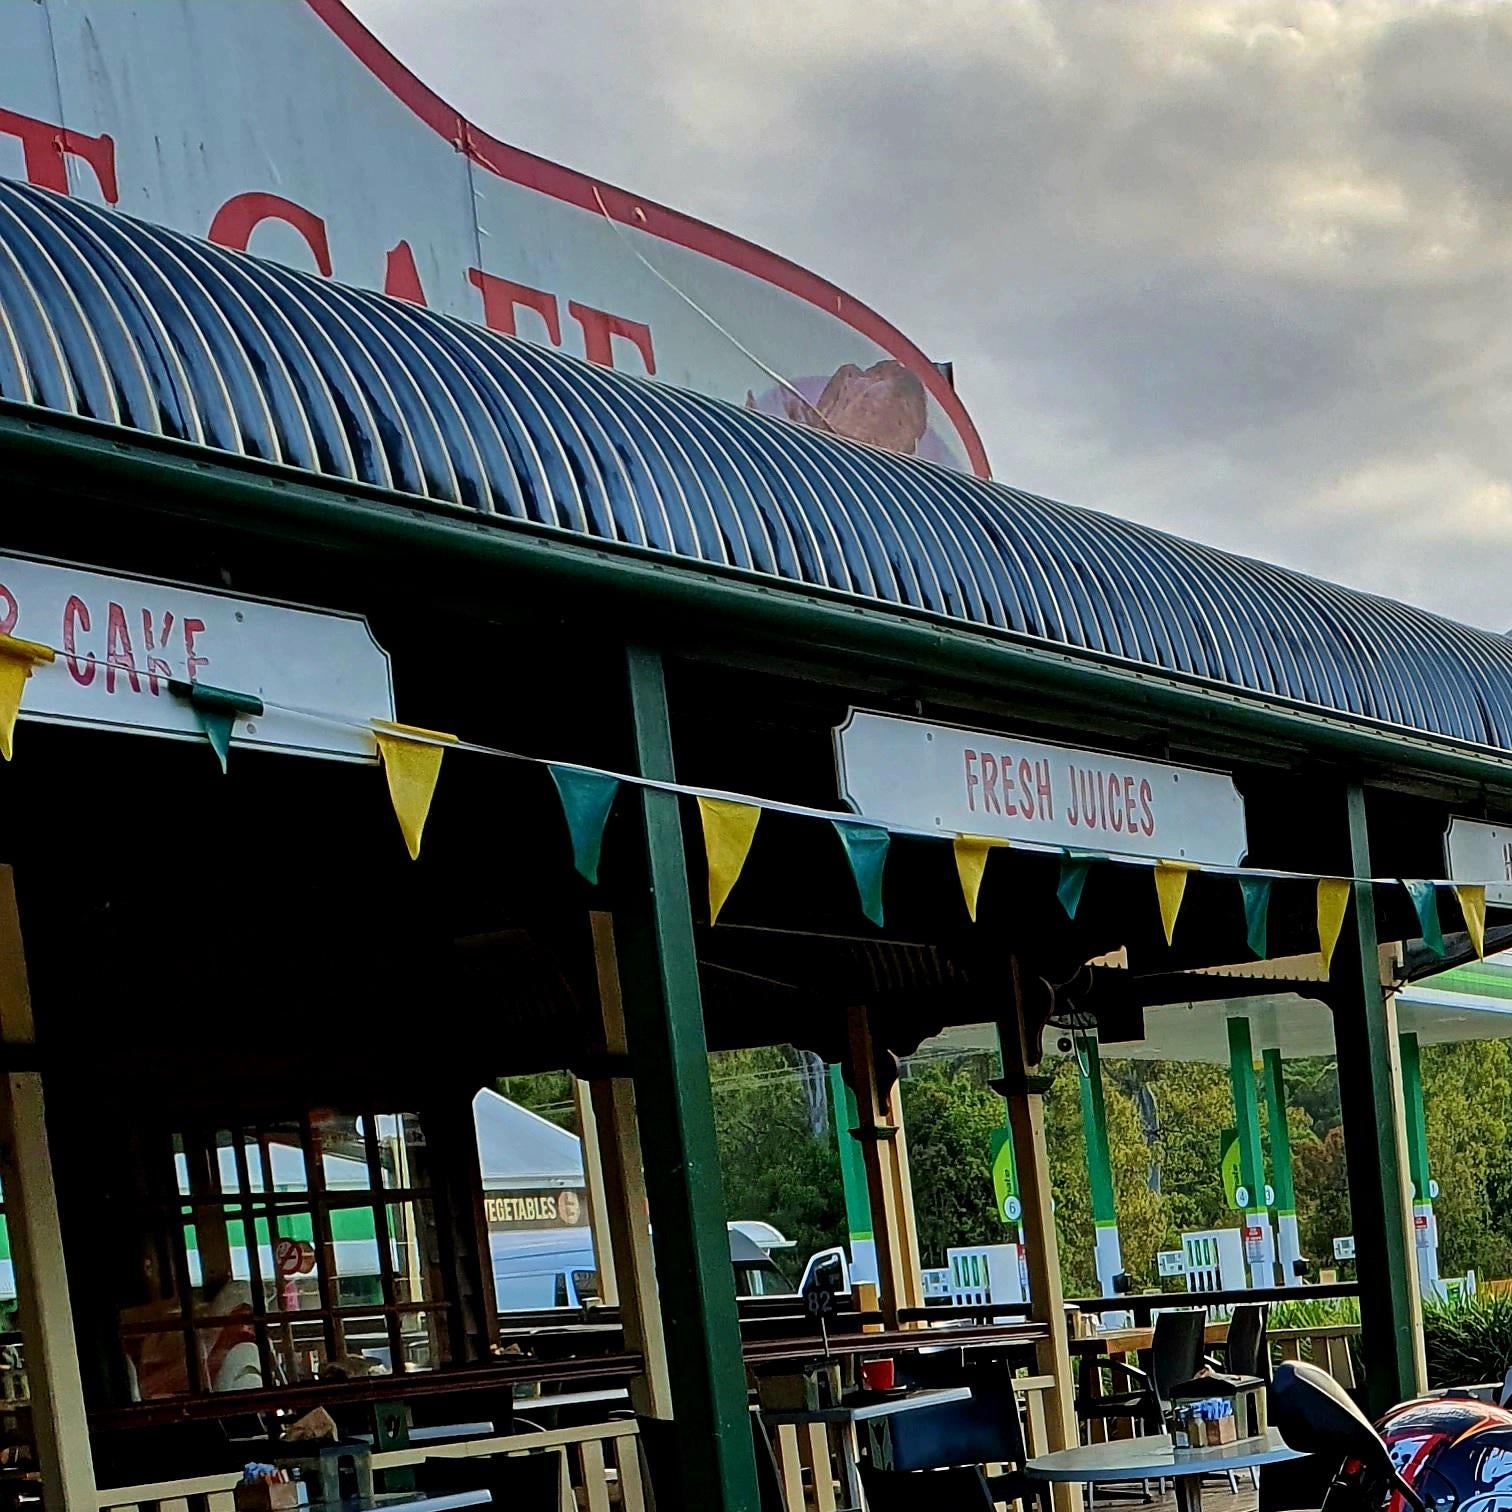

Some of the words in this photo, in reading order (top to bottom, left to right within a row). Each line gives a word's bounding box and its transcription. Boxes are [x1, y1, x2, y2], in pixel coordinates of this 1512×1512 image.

[63, 595, 209, 696] CAKE
[964, 749, 1053, 821] FRESH
[1067, 764, 1154, 837] JUICES
[1009, 1202, 1016, 1214] 6
